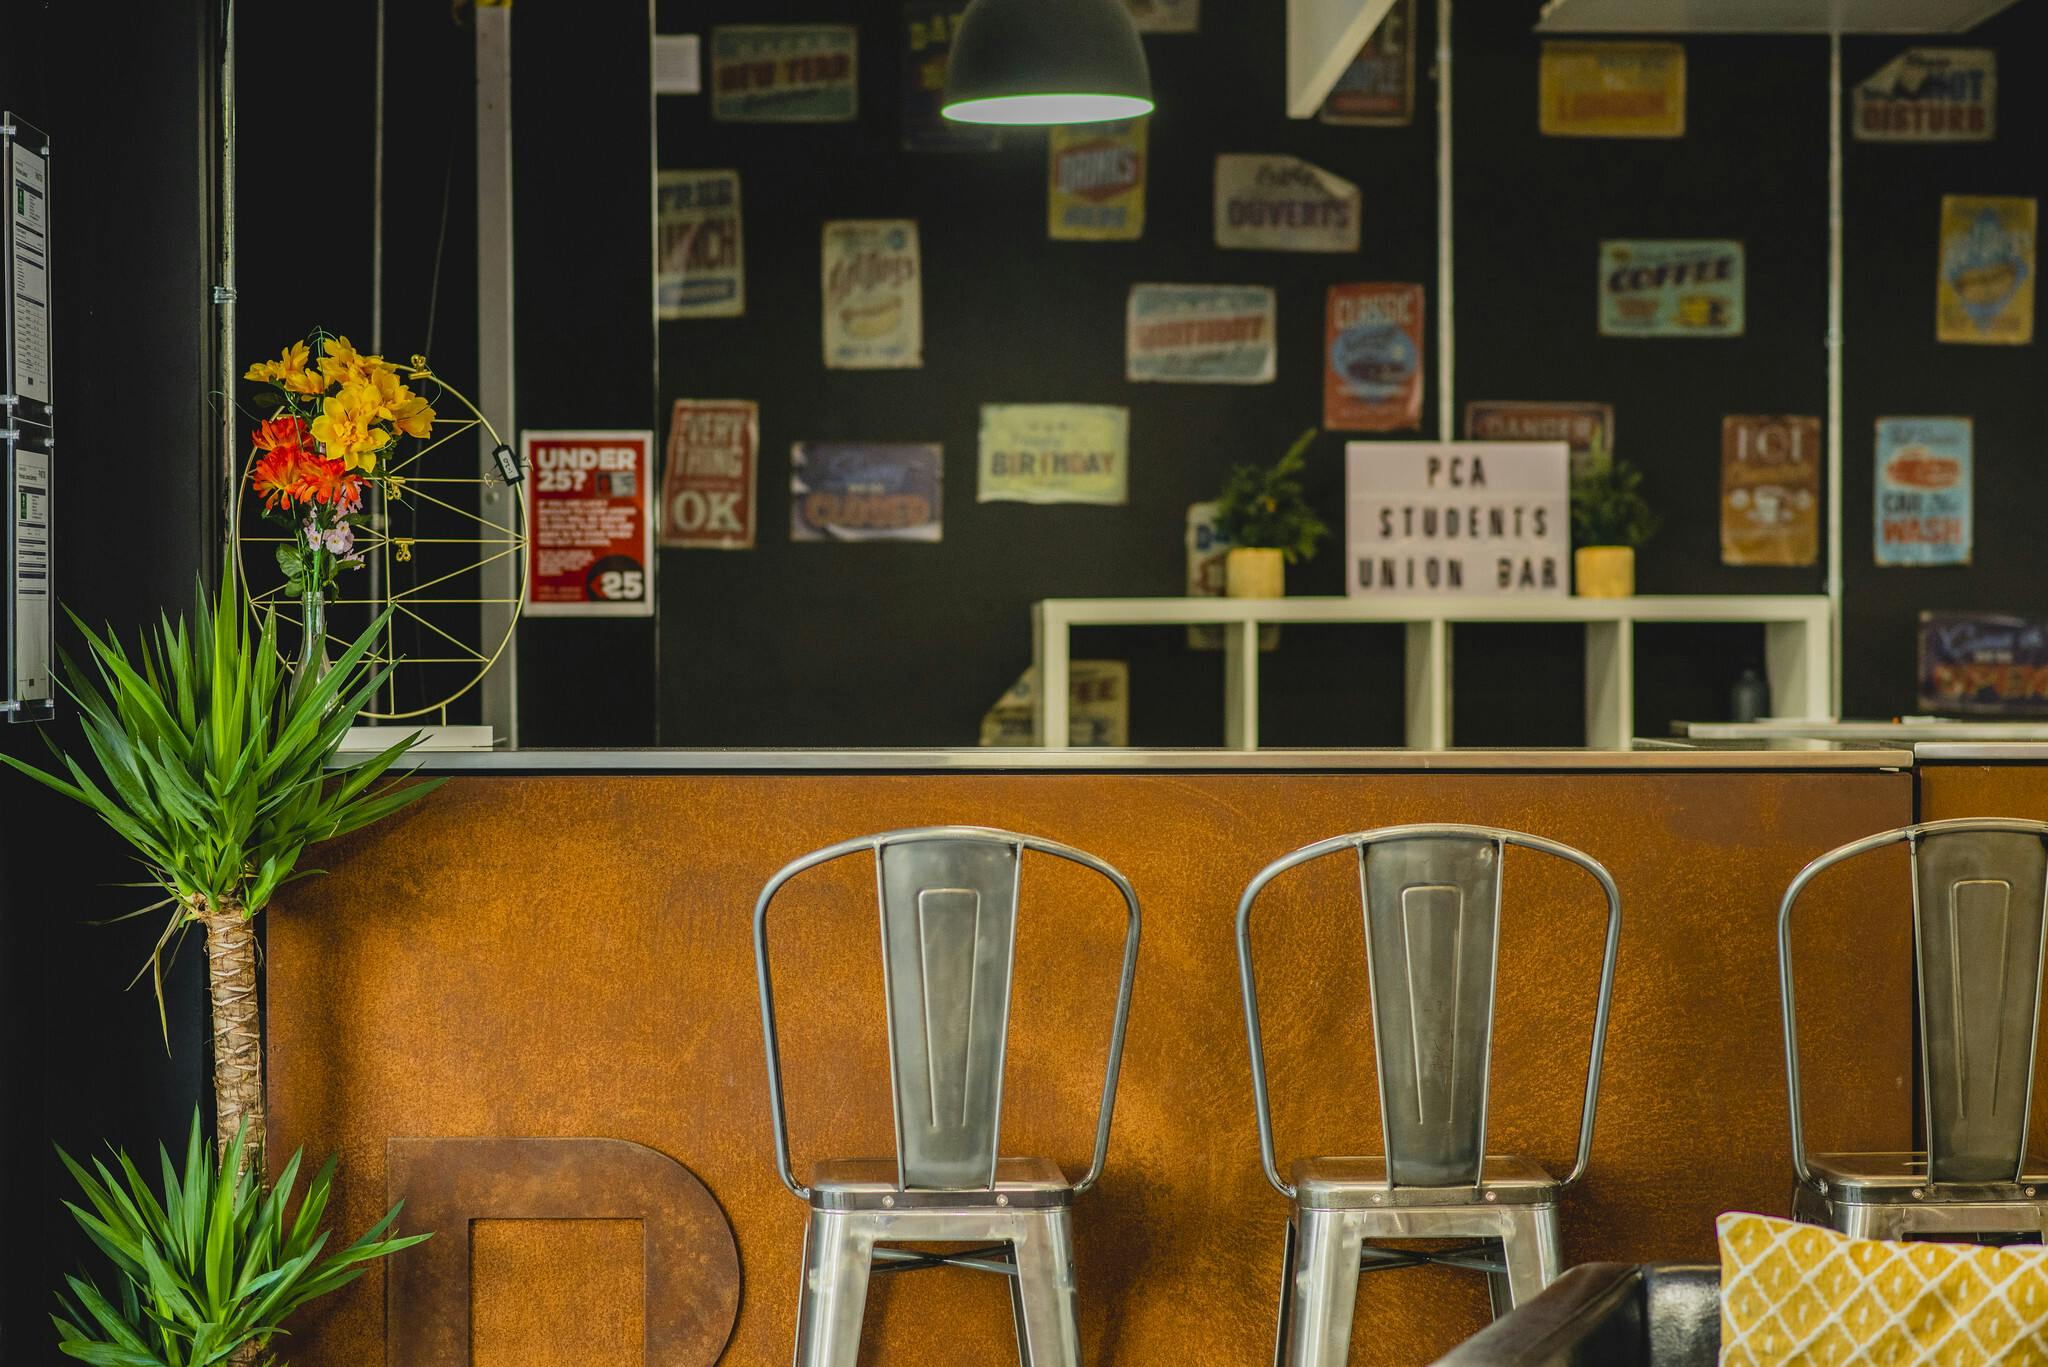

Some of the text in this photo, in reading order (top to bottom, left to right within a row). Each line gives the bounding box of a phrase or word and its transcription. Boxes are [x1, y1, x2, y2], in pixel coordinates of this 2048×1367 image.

[1863, 103, 1986, 130] DISTURB
[1609, 256, 1732, 293] COFFEE
[1333, 291, 1412, 329] CLASSIC
[677, 412, 748, 447] EVERY
[537, 447, 637, 470] UNDER
[673, 445, 744, 479] THING
[992, 451, 1115, 477] BIRTHDAY
[1427, 455, 1486, 487] PCA
[537, 470, 588, 491] 25?
[672, 490, 744, 532] OK
[1884, 492, 1922, 513] CAR
[1379, 506, 1548, 538] STUDENTS
[1884, 517, 1963, 545] WASH
[601, 571, 644, 599] 25
[1359, 557, 1557, 588] UNION BAR
